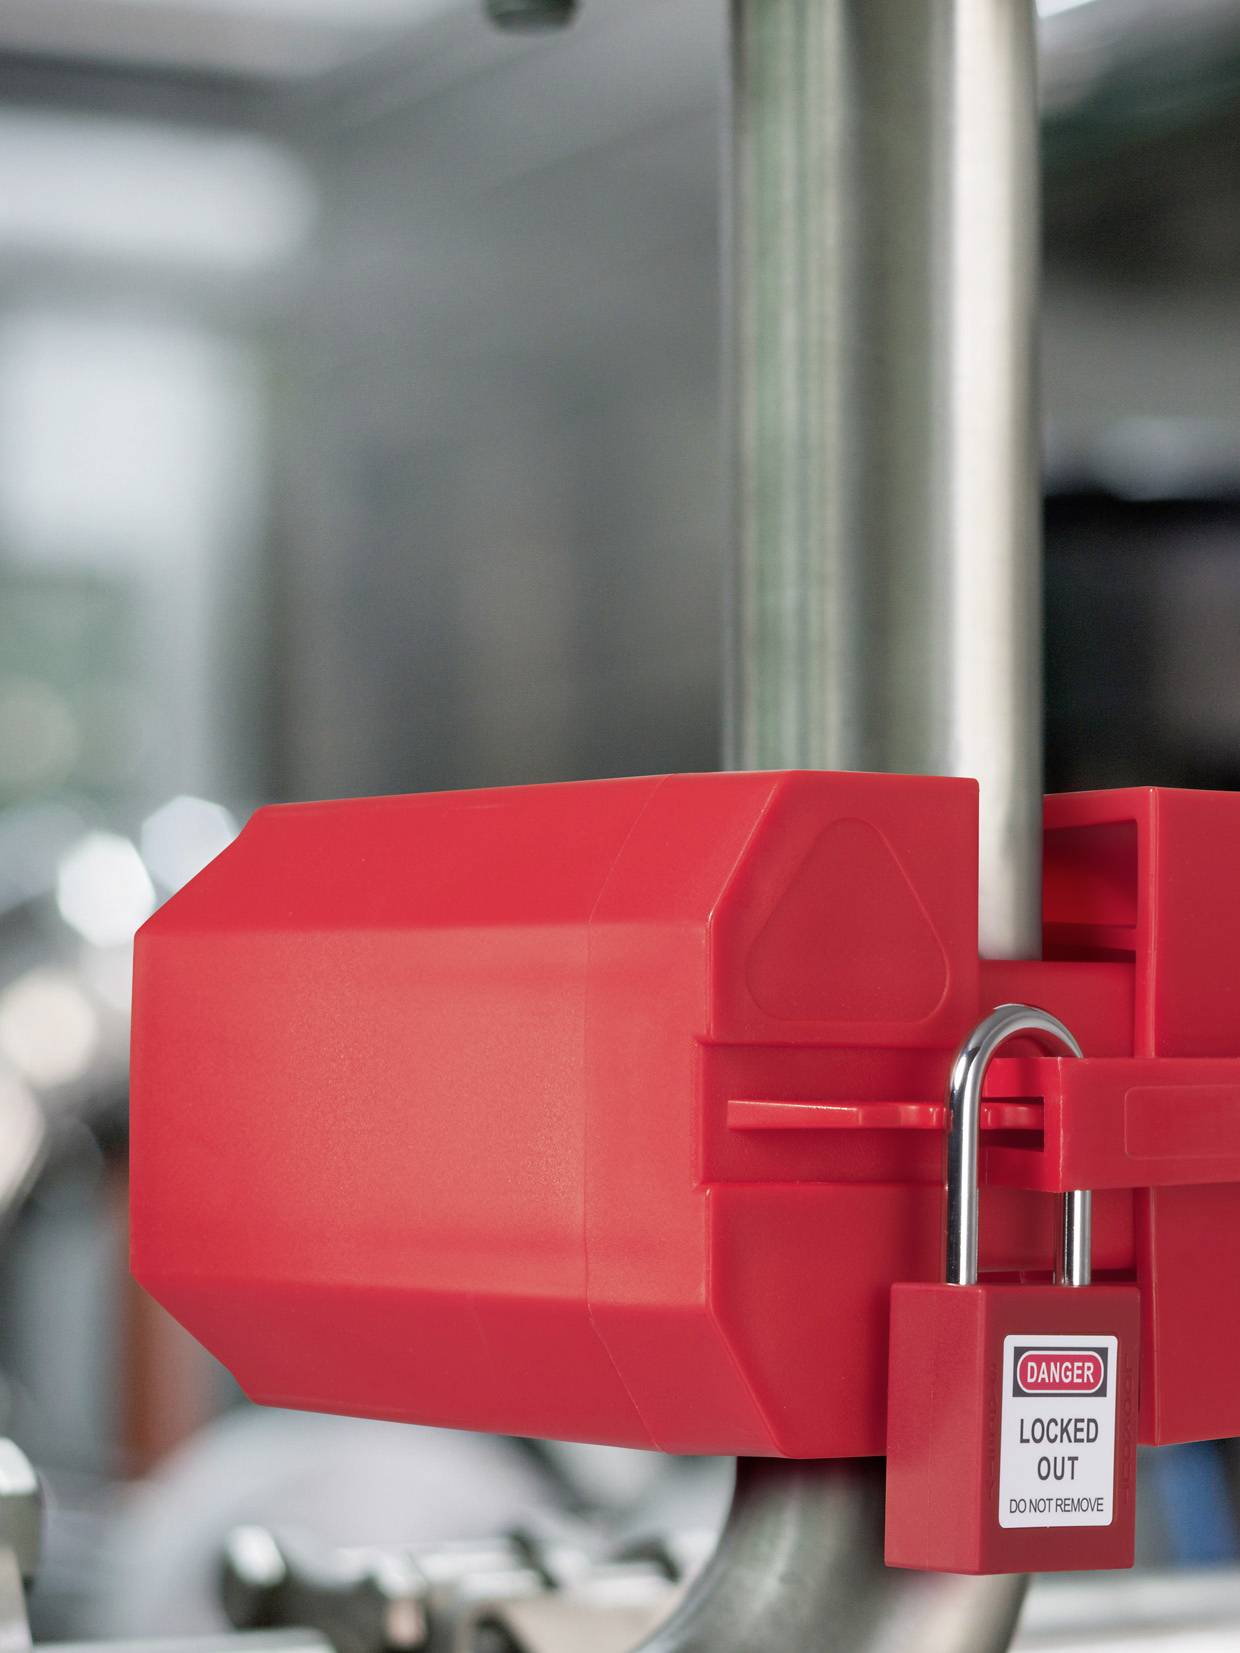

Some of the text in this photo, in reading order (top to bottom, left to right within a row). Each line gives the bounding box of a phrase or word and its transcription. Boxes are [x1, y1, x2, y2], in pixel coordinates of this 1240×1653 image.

[1027, 1361, 1095, 1384] DANGER
[1019, 1417, 1099, 1444] LOCKED
[1037, 1455, 1079, 1481] OUT
[1009, 1497, 1104, 1514] DO NOT REMOVE
